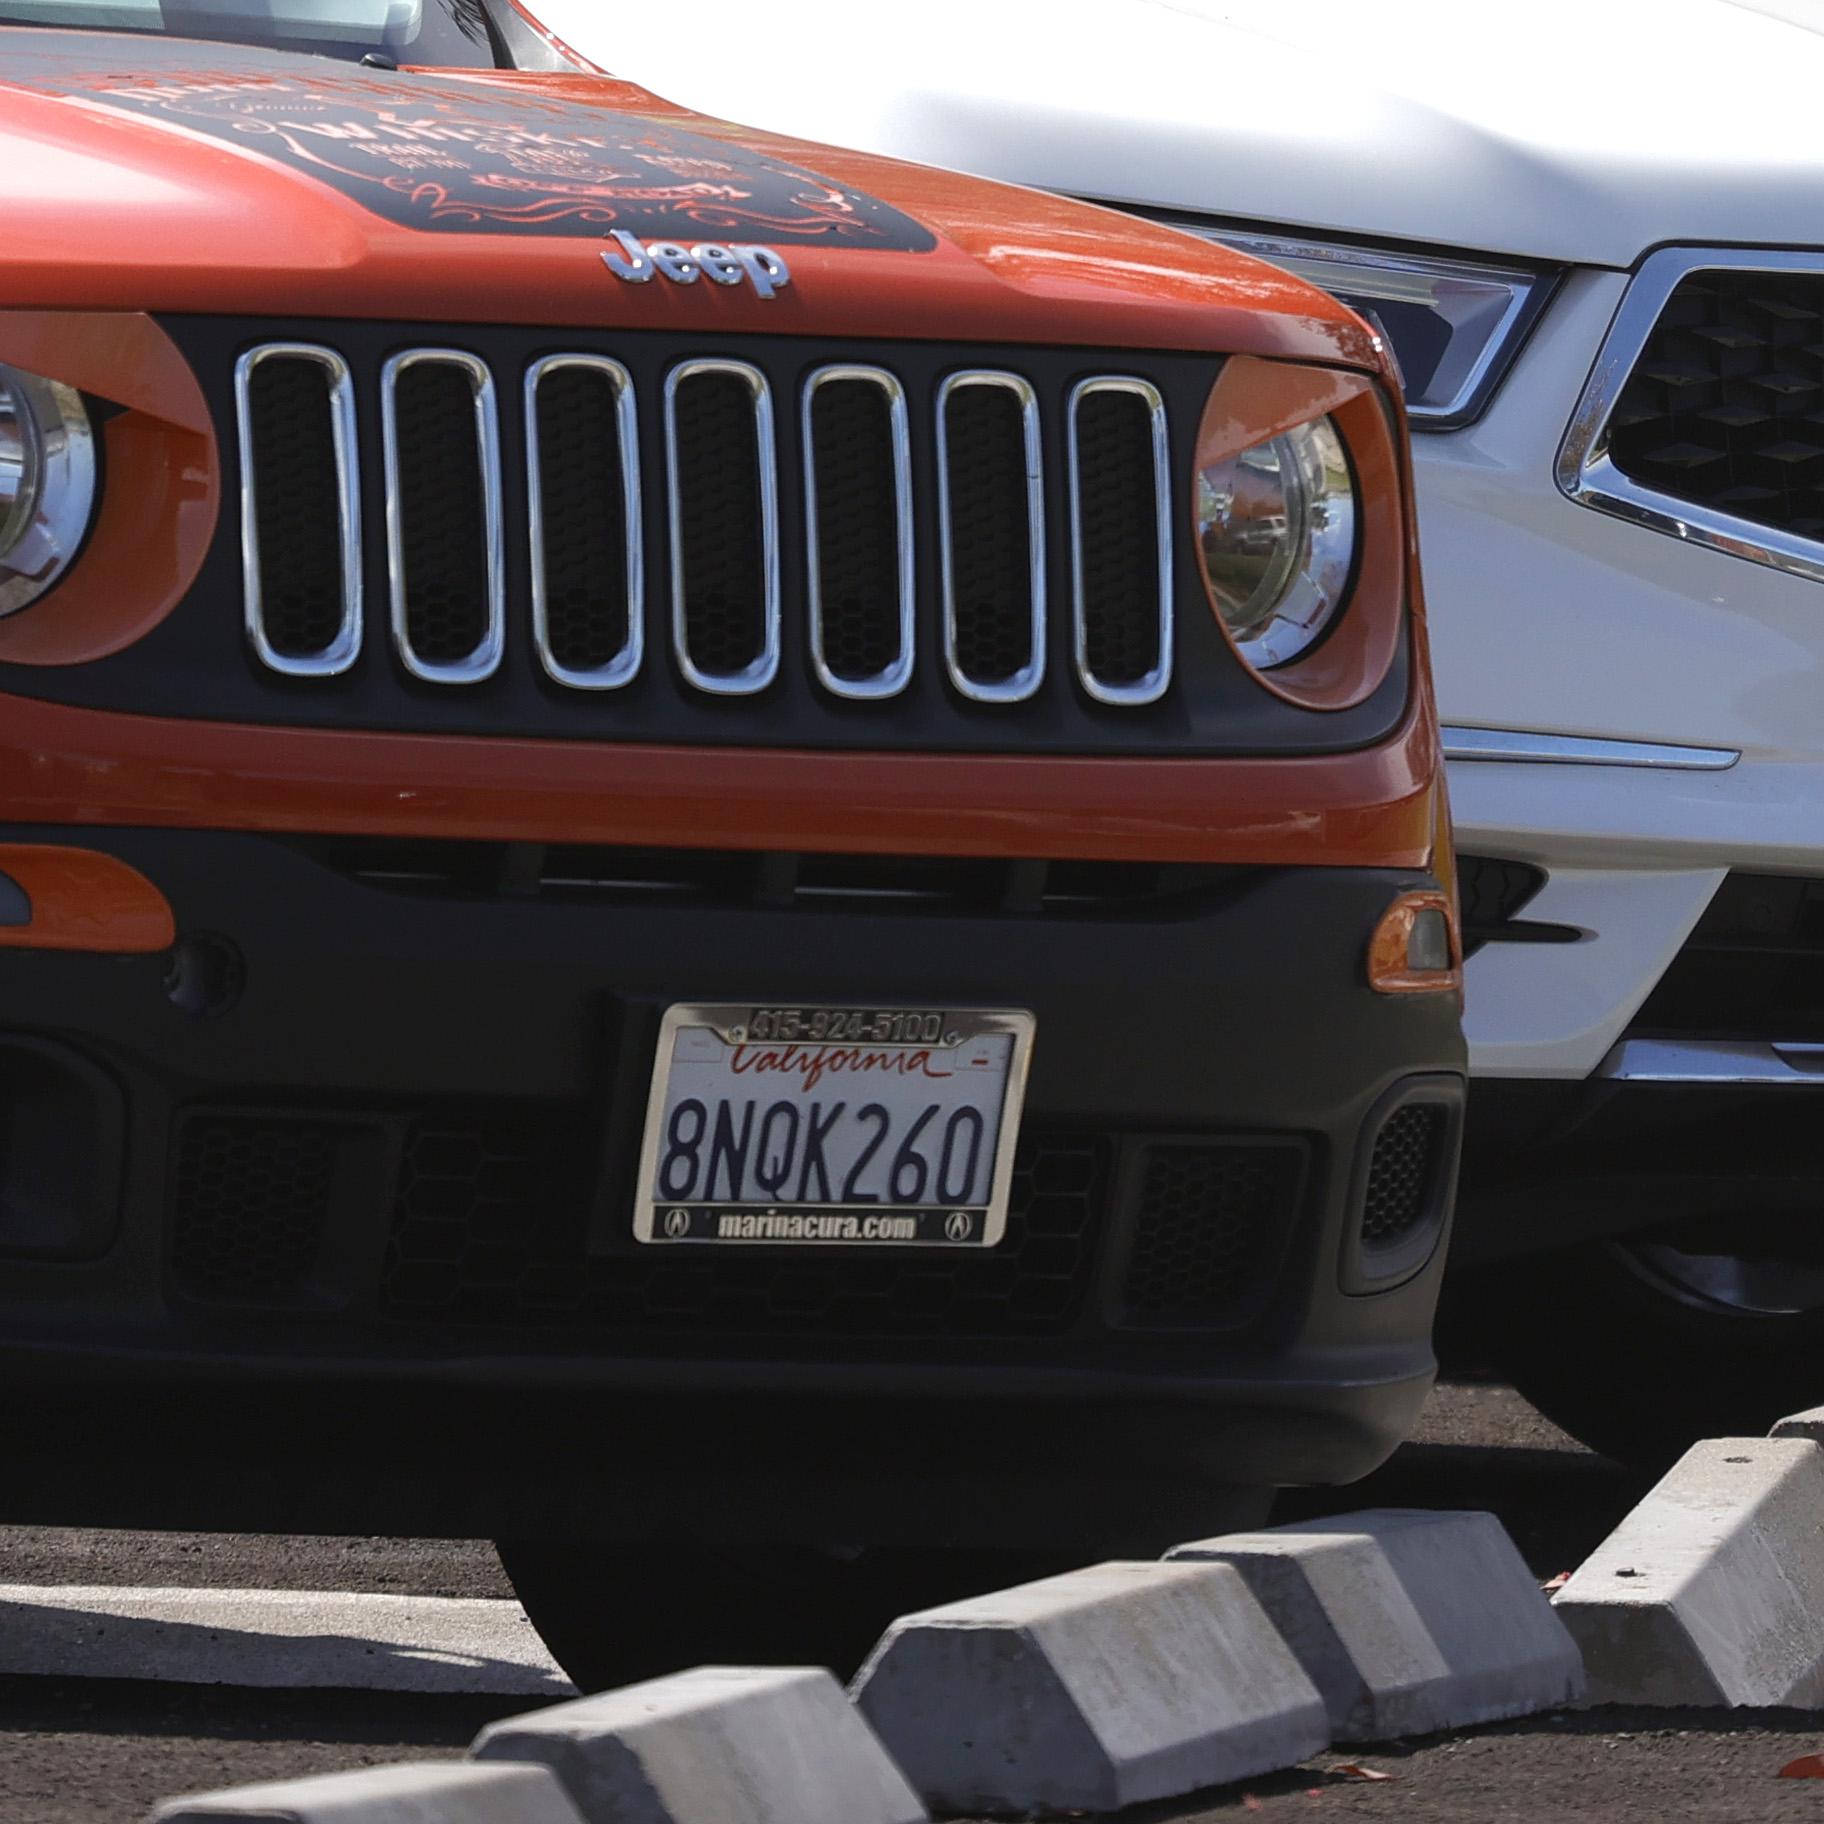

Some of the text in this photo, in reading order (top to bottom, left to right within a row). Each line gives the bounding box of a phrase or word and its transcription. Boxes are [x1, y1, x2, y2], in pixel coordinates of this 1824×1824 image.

[600, 228, 791, 300] Jeep
[748, 1009, 944, 1044] 415-924-5100
[729, 1044, 953, 1093] California
[658, 1097, 984, 1205] 8NQK260
[717, 1209, 917, 1240] marinacura.com
